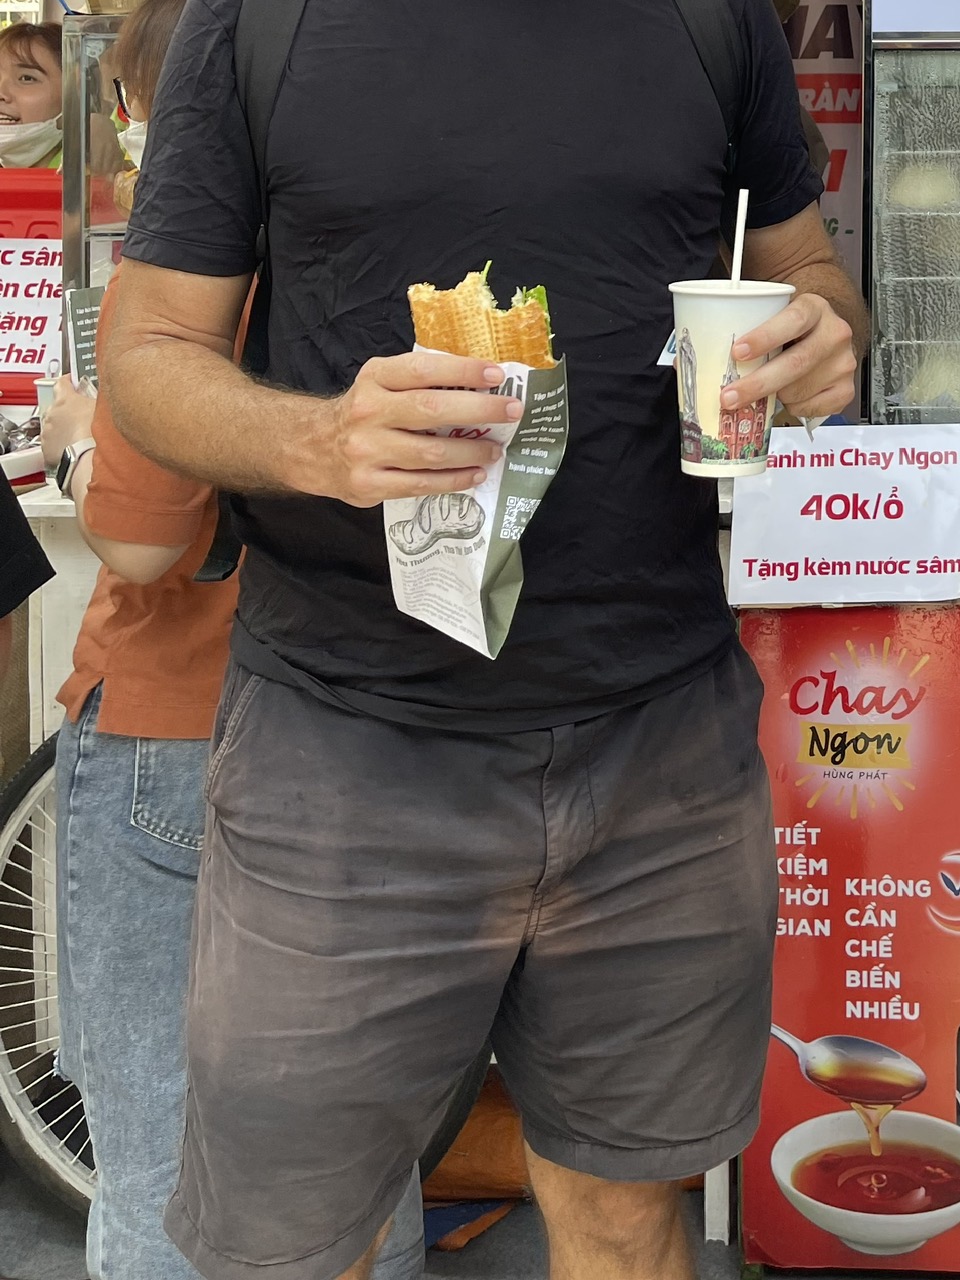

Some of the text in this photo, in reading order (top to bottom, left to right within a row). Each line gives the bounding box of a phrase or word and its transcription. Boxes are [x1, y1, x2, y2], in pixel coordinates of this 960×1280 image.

[798, 80, 862, 112] RÀN
[0, 311, 48, 336] ặng
[766, 447, 958, 470] ánh mì Chay Ngon
[800, 486, 904, 521] 40k/ổ
[742, 558, 799, 582] Tặng
[804, 557, 851, 577] kèm
[855, 557, 910, 575] nước
[789, 669, 926, 720] Chay
[808, 725, 901, 766] Ngon
[823, 768, 888, 781] HÙNG PHÁT
[845, 874, 931, 897] KHÔNG
[845, 901, 897, 927] CẦN
[845, 933, 893, 958] CHẾ
[845, 963, 900, 989] BIẾN
[845, 995, 920, 1020] NHIỀU
